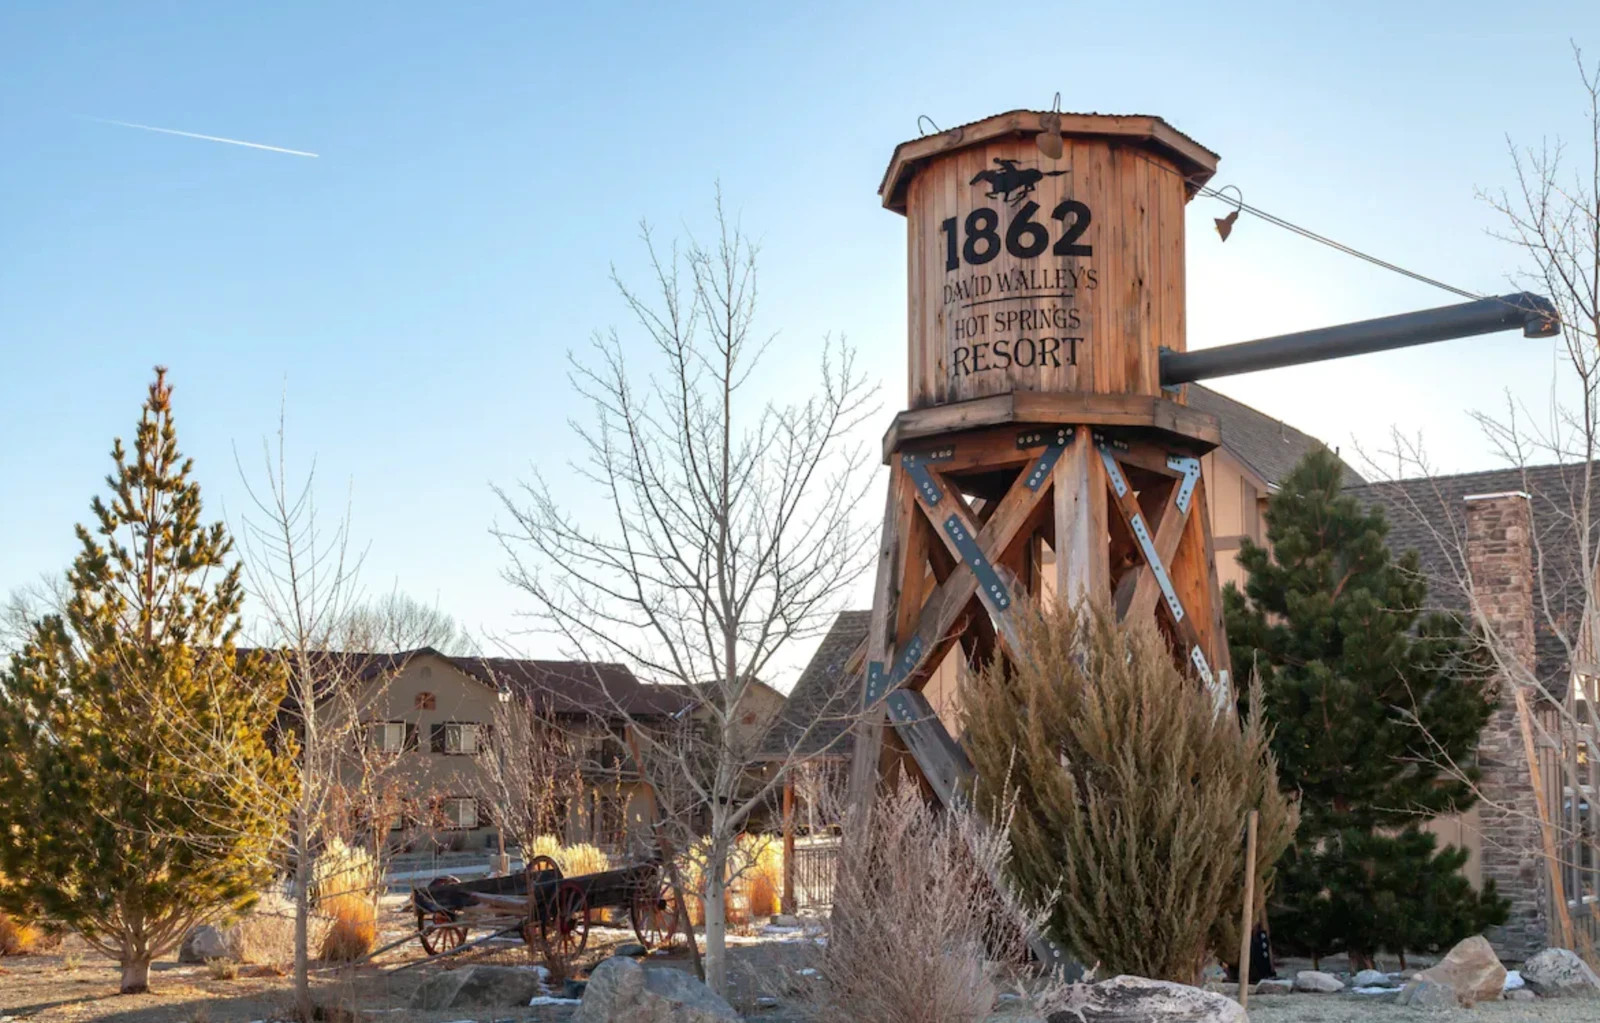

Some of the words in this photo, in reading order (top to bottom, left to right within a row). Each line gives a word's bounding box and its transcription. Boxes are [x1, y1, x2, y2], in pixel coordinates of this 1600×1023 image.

[942, 200, 1093, 272] 1862
[943, 274, 992, 305] DAVID
[996, 266, 1099, 293] WALLEY'S
[955, 314, 989, 340] HOT
[994, 308, 1082, 333] SPRINGS
[952, 336, 1084, 376] RESORT
